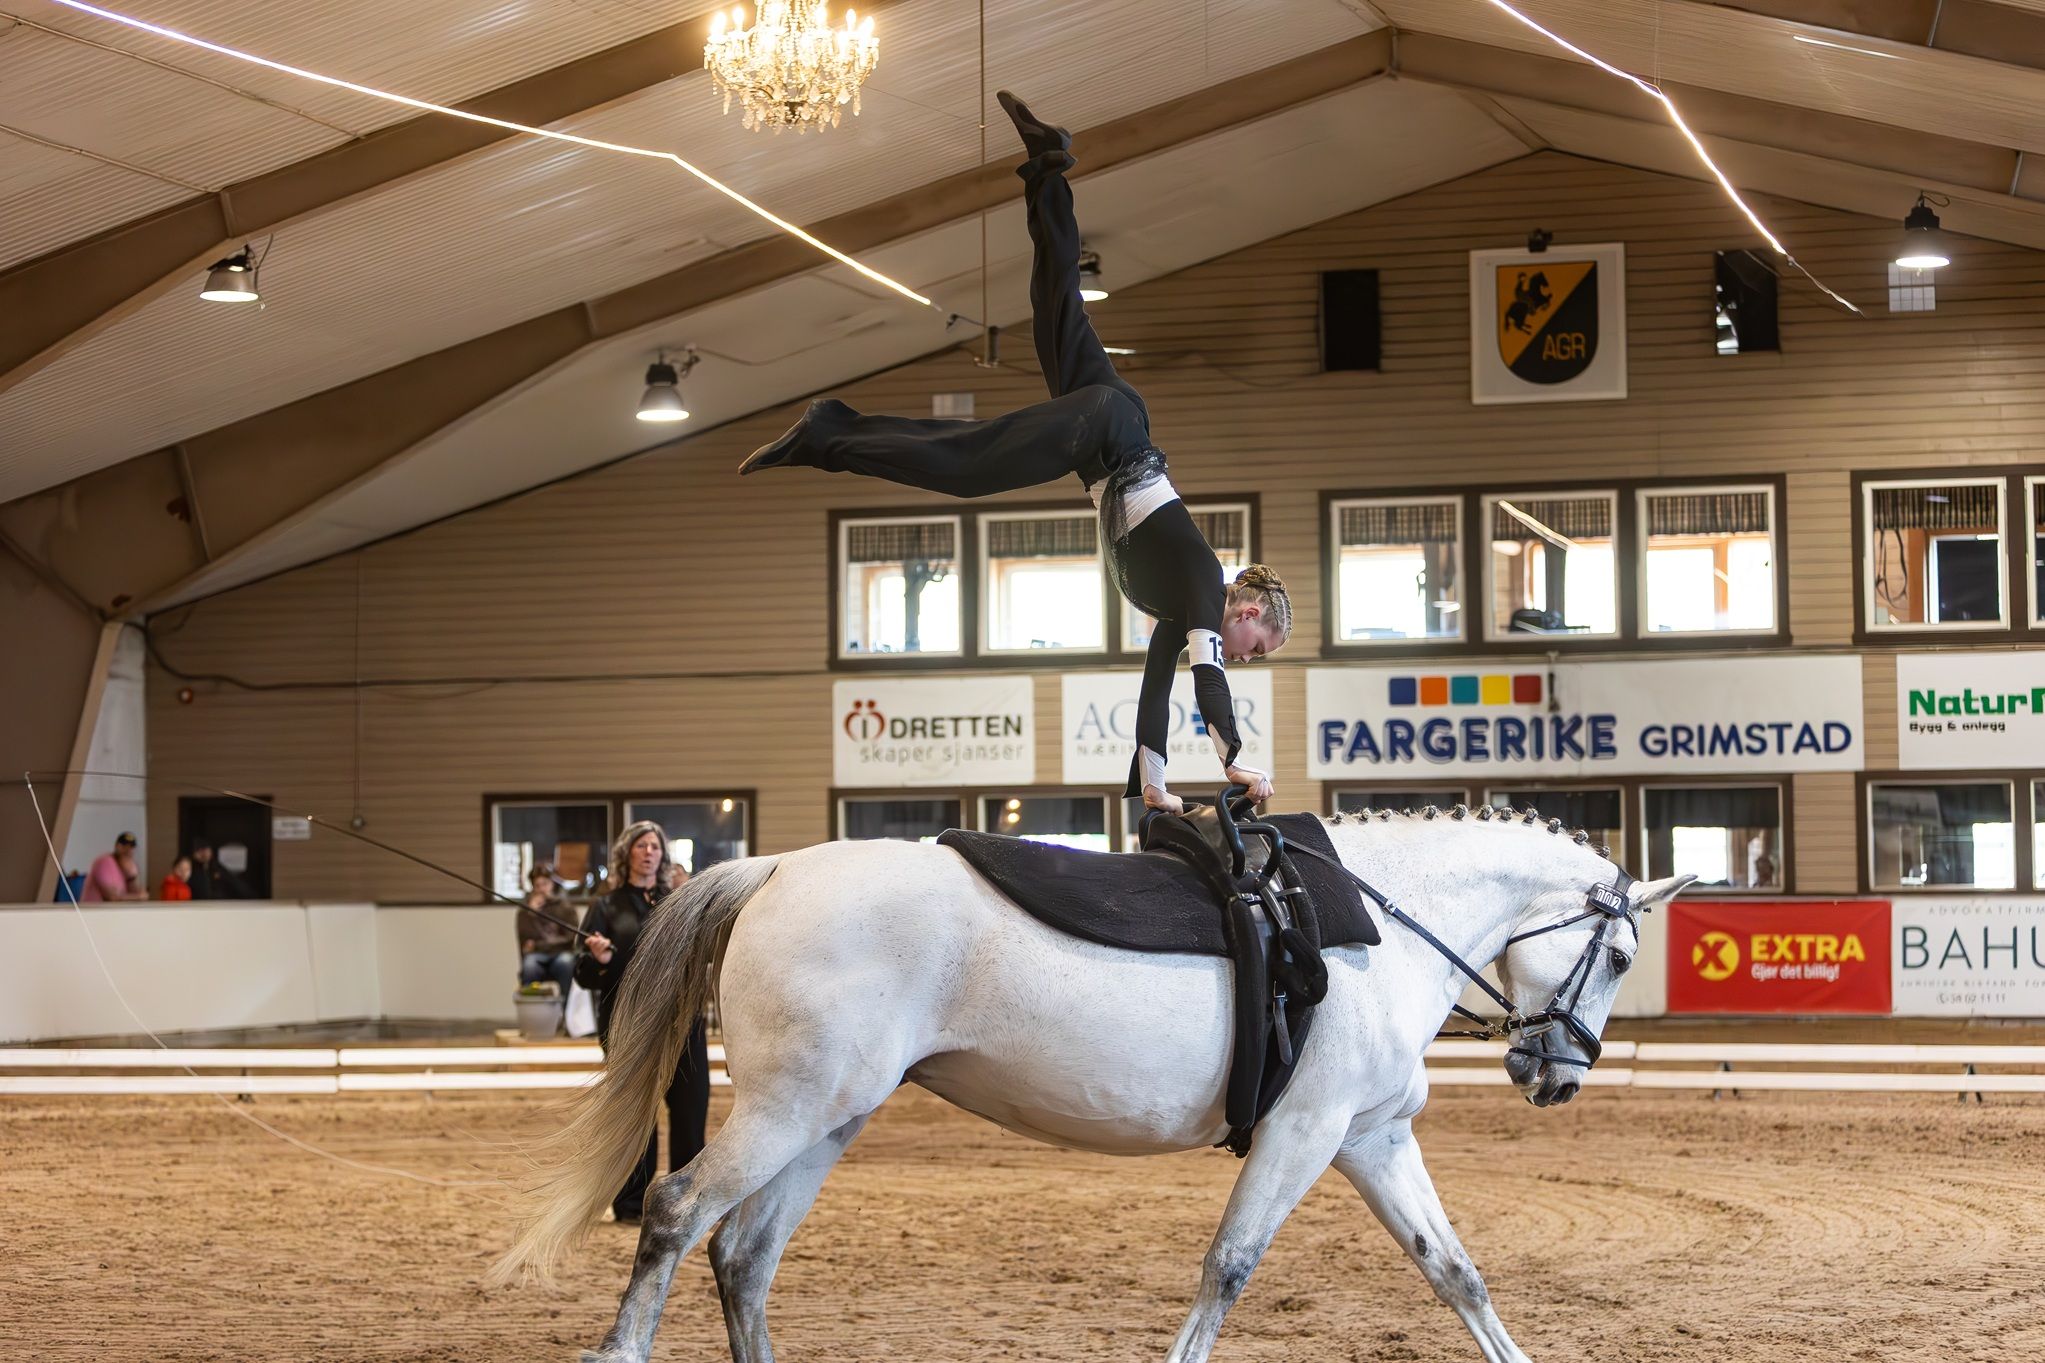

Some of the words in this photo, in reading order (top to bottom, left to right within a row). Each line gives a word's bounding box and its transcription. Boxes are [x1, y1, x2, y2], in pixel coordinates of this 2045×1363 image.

[1542, 332, 1586, 361] AGR
[1317, 714, 1619, 765] FARGERIKE
[1639, 721, 1853, 757] GRIMSTAD
[1909, 722, 1943, 734] Bygg
[1947, 720, 1957, 732] &
[1962, 721, 2006, 733] anlegg
[859, 743, 935, 767] skaper
[942, 741, 1024, 767] sjanser
[1751, 934, 1865, 961] EXTRA
